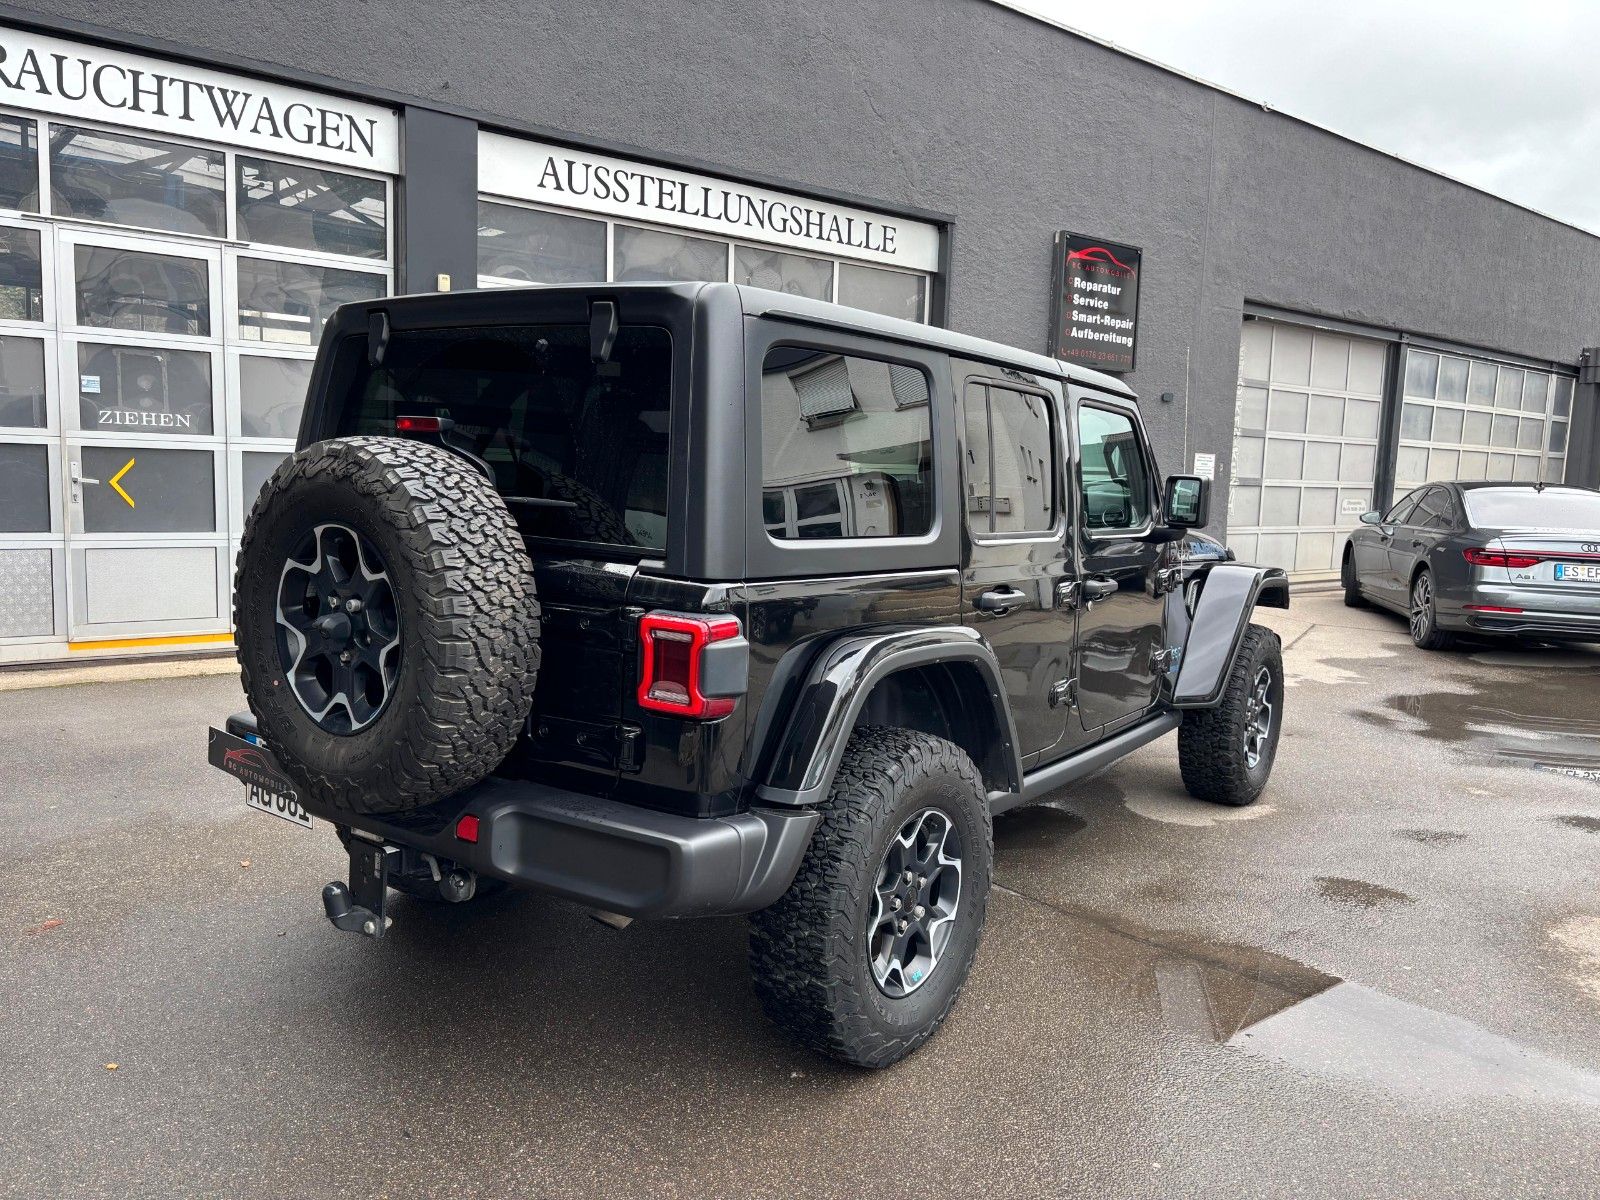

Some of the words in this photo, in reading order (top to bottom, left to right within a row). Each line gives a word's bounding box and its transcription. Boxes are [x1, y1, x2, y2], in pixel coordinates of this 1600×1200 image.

[537, 156, 897, 255] AUSSTELLUNGSHALLE
[1074, 277, 1121, 296] Reparatur
[1072, 293, 1109, 310] Service
[1072, 310, 1133, 330] Smart-Repair
[1070, 326, 1133, 347] Aufbereitung
[98, 410, 192, 428] ZIEHEN
[1563, 566, 1579, 577] ES
